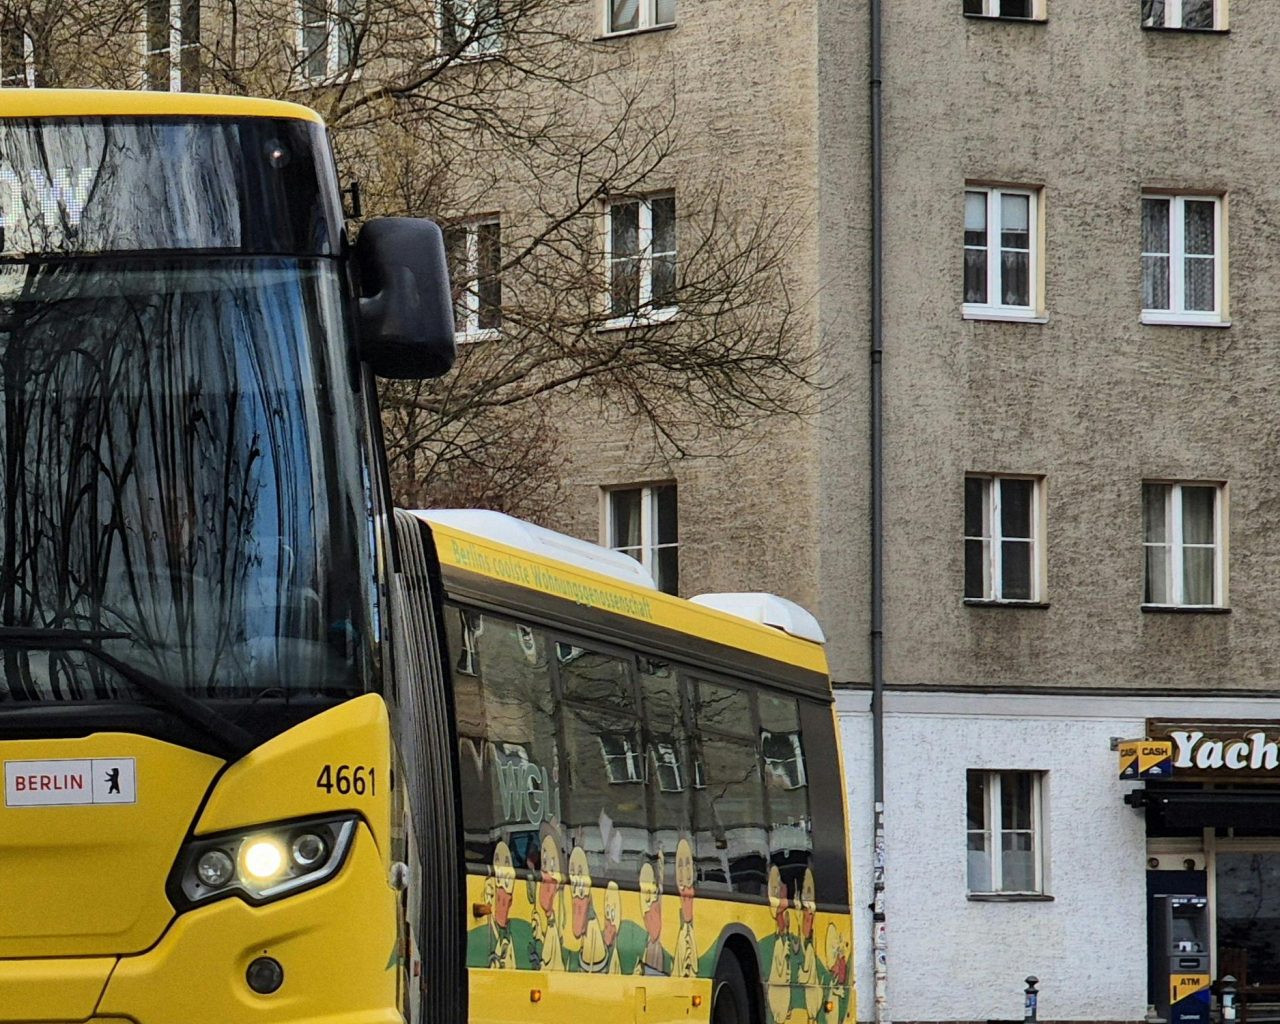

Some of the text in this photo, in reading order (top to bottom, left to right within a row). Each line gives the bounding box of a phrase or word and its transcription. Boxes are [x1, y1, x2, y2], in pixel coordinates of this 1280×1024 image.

[451, 540, 491, 571] Berlins
[493, 557, 529, 584] coolste
[1142, 747, 1168, 756] CASH
[15, 774, 83, 791] BERLIN
[317, 764, 375, 796] 4661
[1180, 978, 1200, 986] ATM
